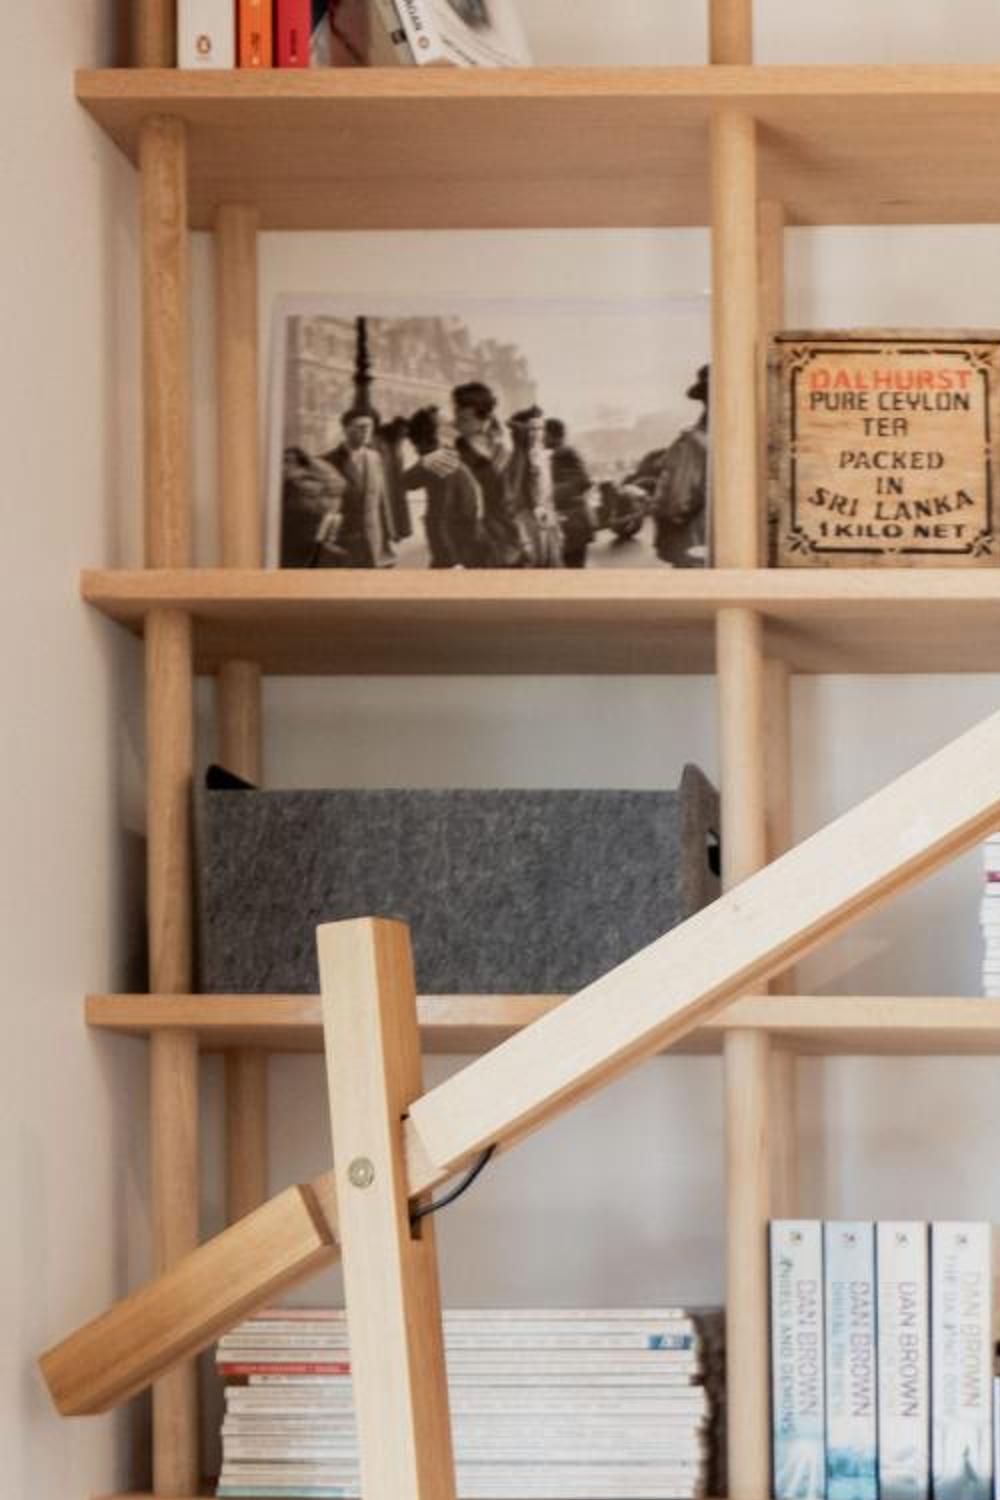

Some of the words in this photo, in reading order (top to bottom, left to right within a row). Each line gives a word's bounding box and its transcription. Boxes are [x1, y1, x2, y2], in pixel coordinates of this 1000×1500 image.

[809, 369, 972, 391] DALHURST
[809, 391, 871, 412] PURE
[878, 391, 971, 412] CEYLON
[862, 417, 909, 437] TEA
[839, 451, 944, 470] PACKED
[807, 487, 859, 517] SRI
[874, 489, 975, 521] LANKA
[876, 477, 904, 495] IN
[913, 524, 967, 539] NET
[797, 1280, 817, 1326] DAN
[851, 1280, 871, 1327] DAN
[898, 1281, 917, 1327] DAN
[961, 1271, 980, 1317] DAN
[798, 1332, 818, 1417] BROWN
[851, 1333, 872, 1418] BROWN
[898, 1333, 919, 1418] BROWN
[962, 1324, 981, 1408] BROWN
